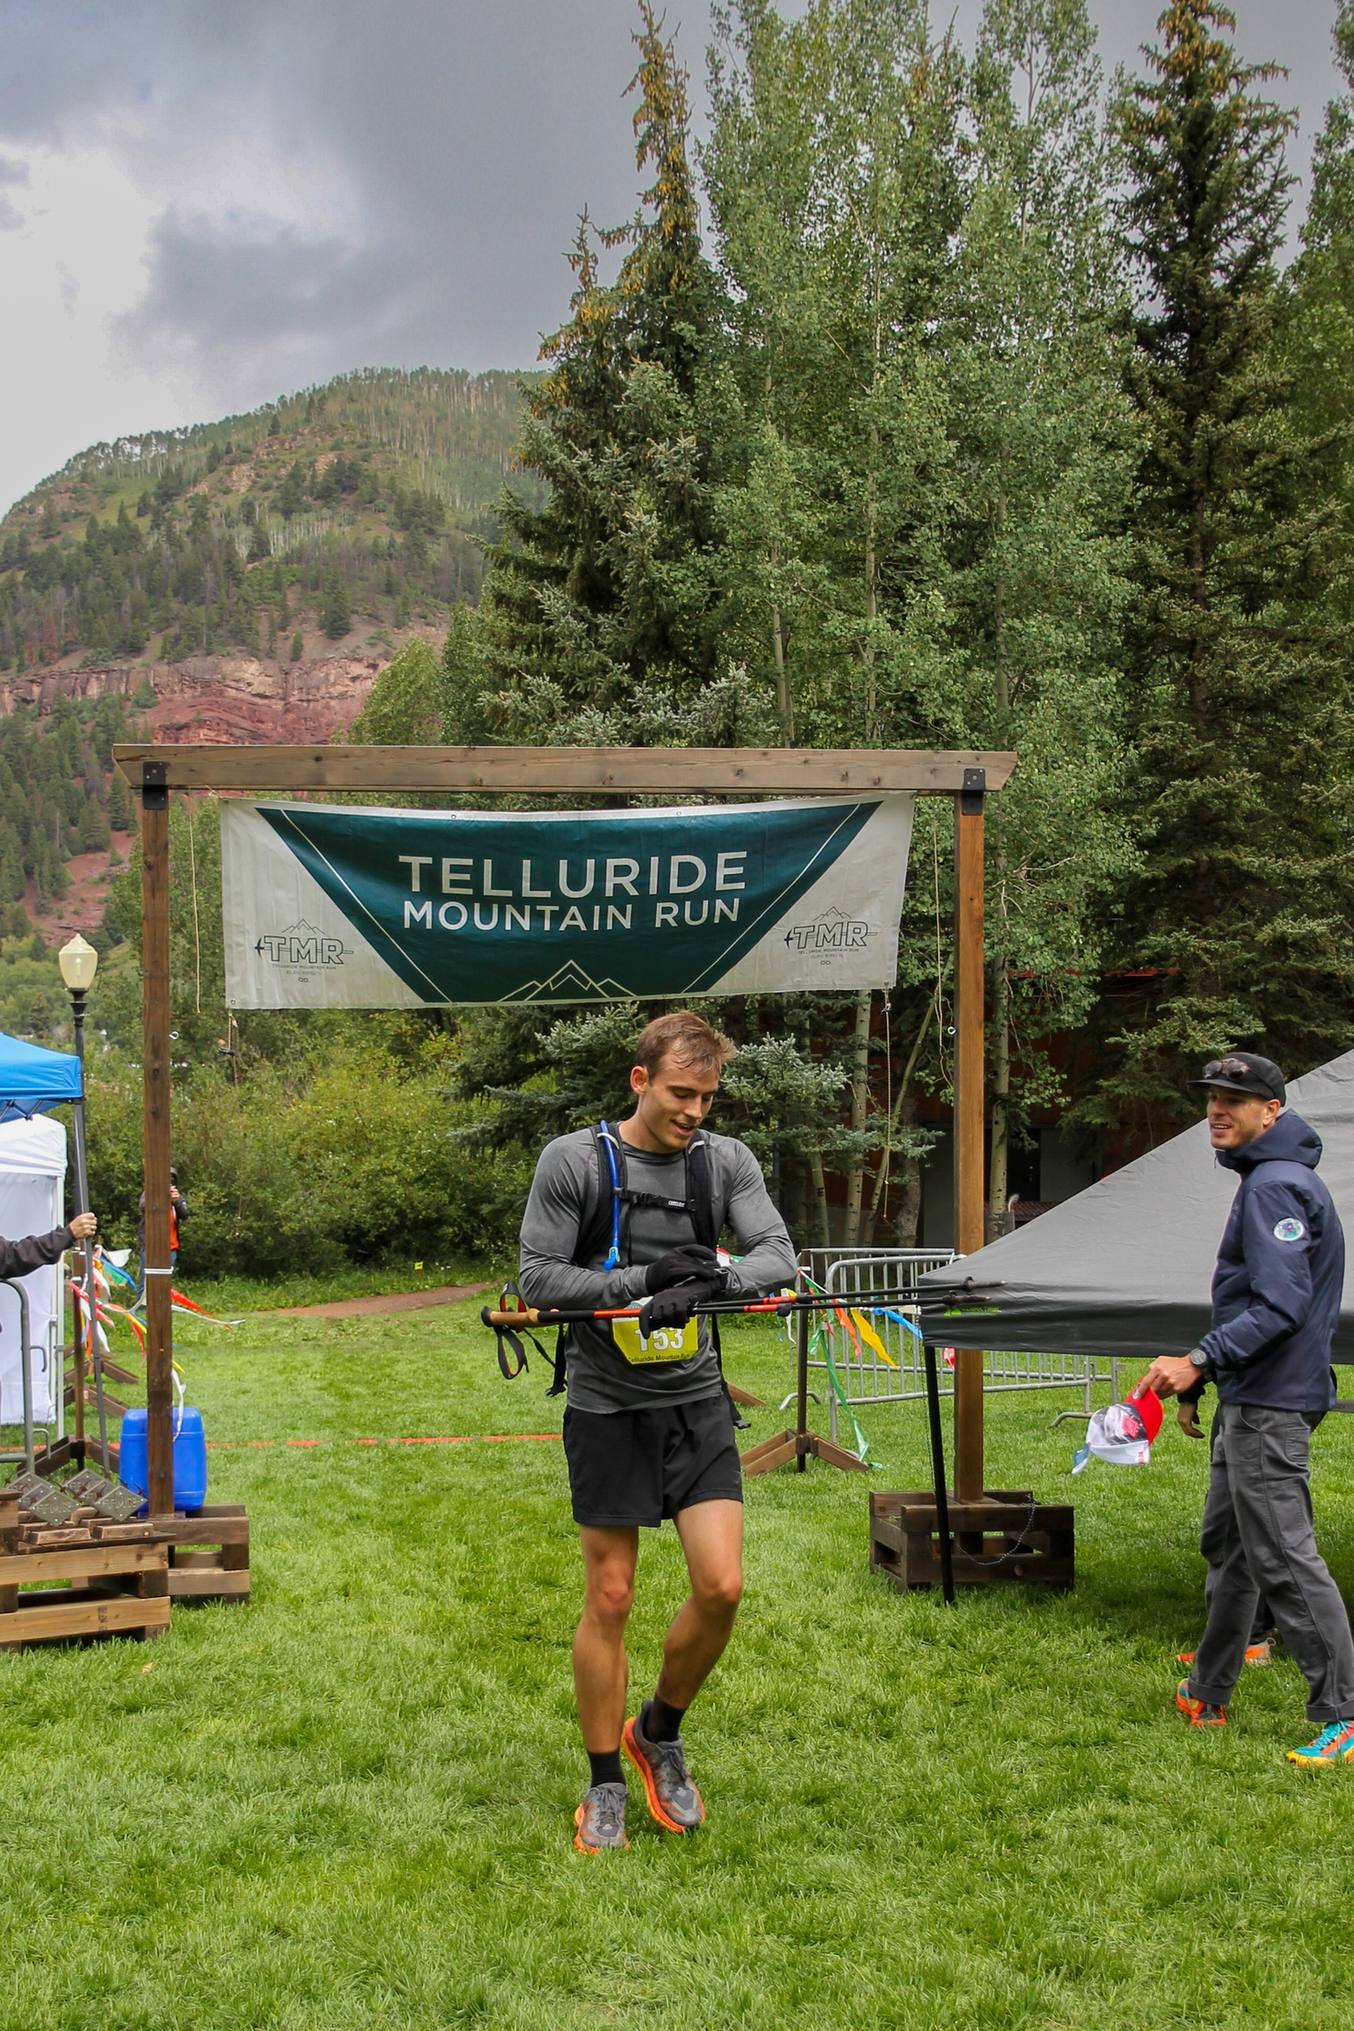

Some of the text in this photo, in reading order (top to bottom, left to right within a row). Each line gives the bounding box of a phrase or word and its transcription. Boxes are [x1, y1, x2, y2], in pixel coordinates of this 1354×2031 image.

[399, 851, 747, 898] TELLURIDE
[403, 898, 739, 931] MOUNTAIN RUN
[793, 921, 868, 949] TMR
[264, 936, 344, 964] TMR
[634, 1327, 684, 1351] 153
